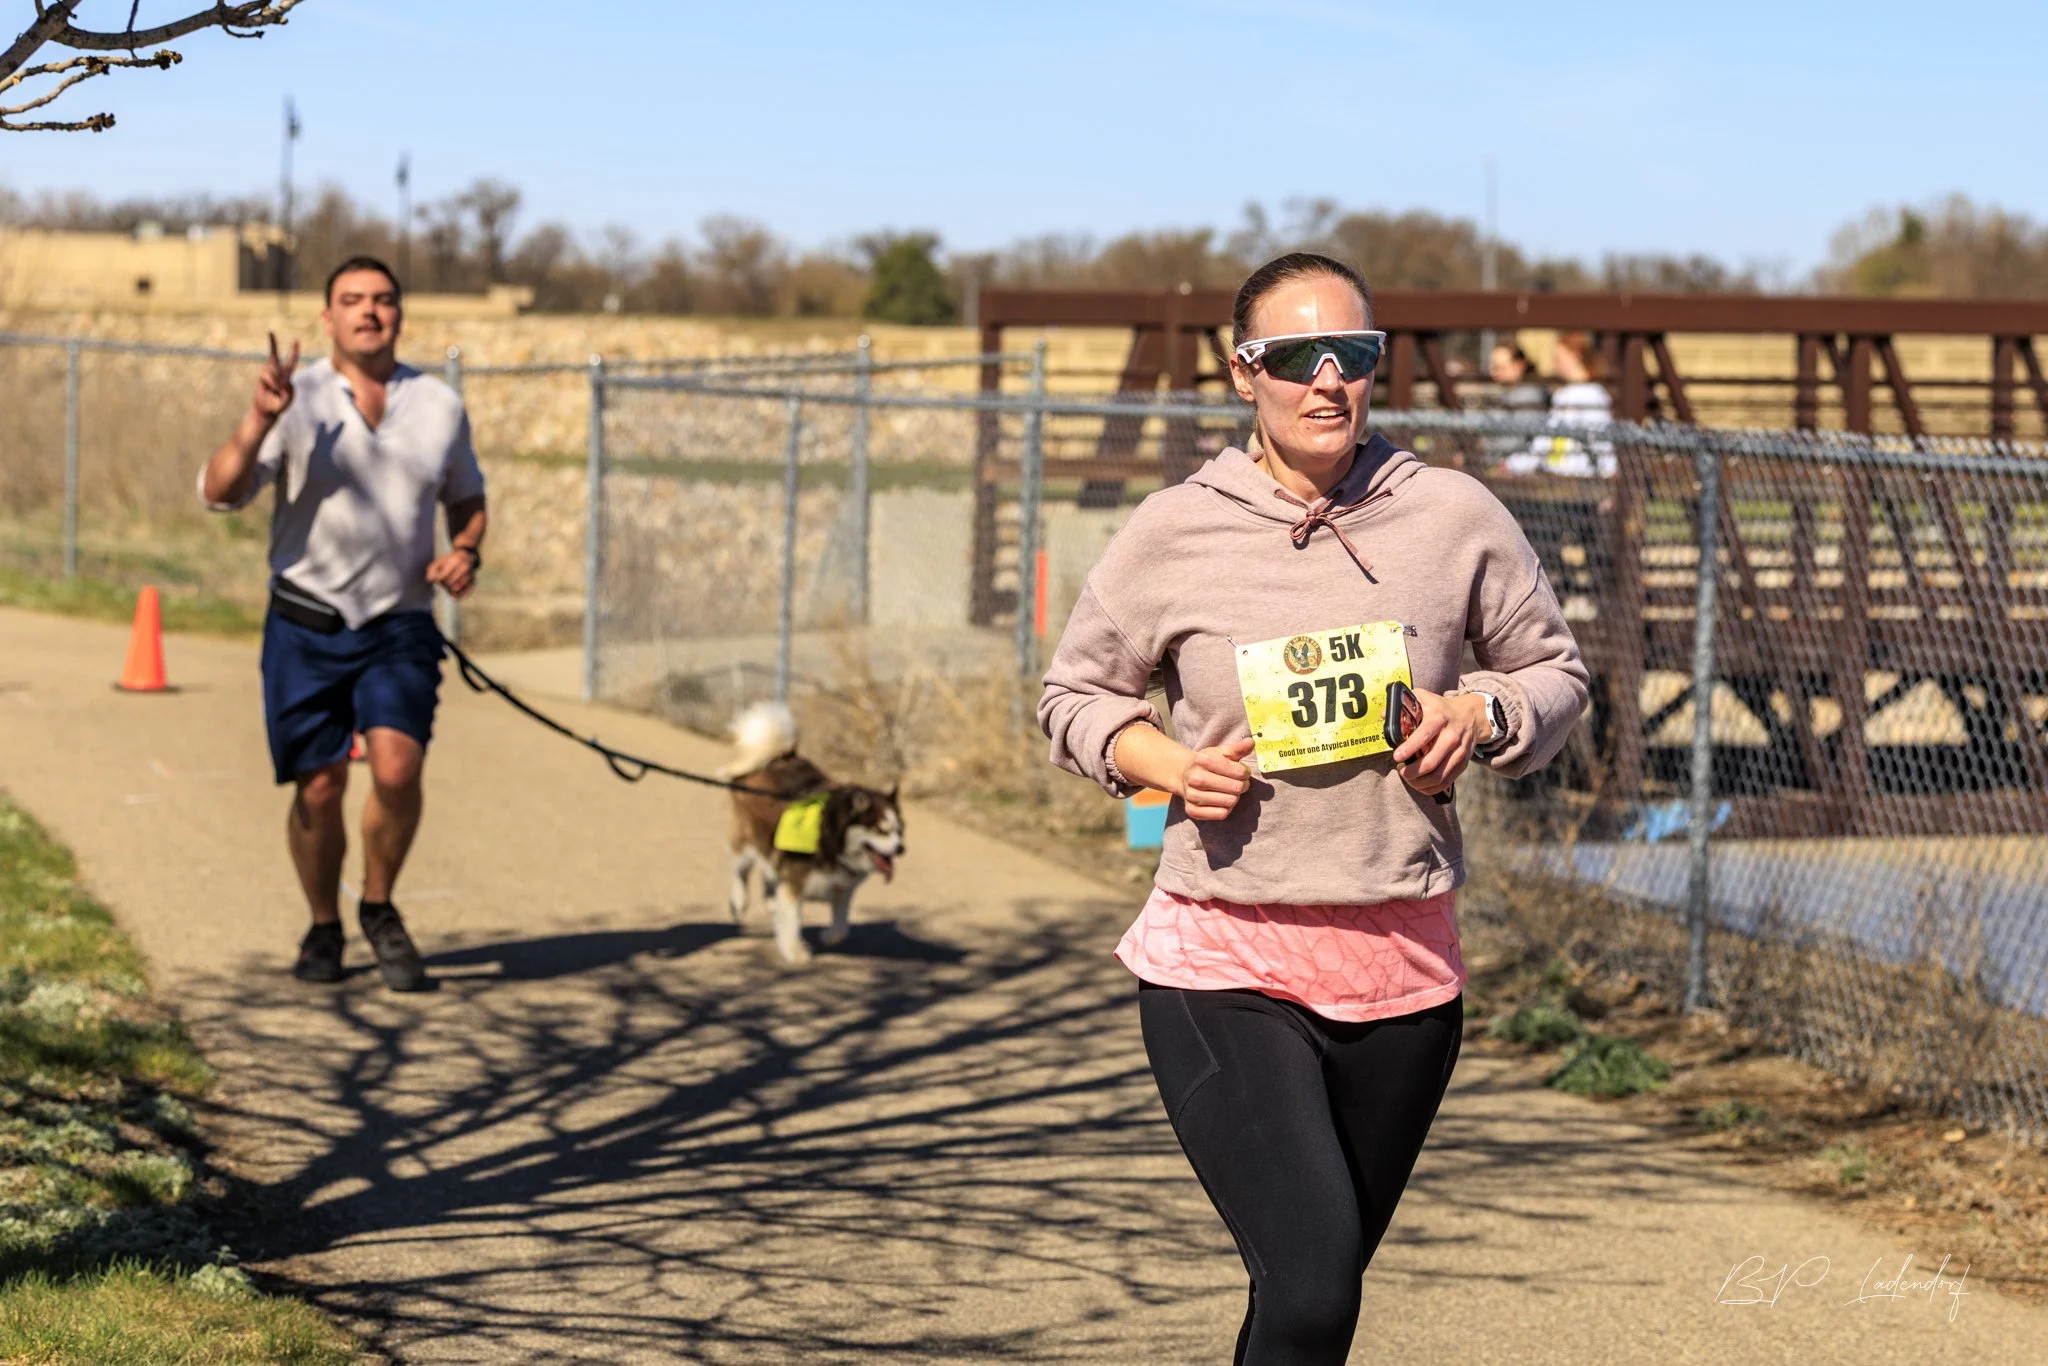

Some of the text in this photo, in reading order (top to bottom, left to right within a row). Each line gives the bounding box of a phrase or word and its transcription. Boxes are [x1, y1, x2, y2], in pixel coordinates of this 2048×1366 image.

[1329, 633, 1364, 662] 5K
[1287, 673, 1368, 728] 373
[1278, 749, 1296, 758] Good
[1296, 748, 1306, 756] for
[1307, 745, 1320, 754] one
[1321, 739, 1350, 752] Atypical
[1350, 734, 1380, 746] Beverage
